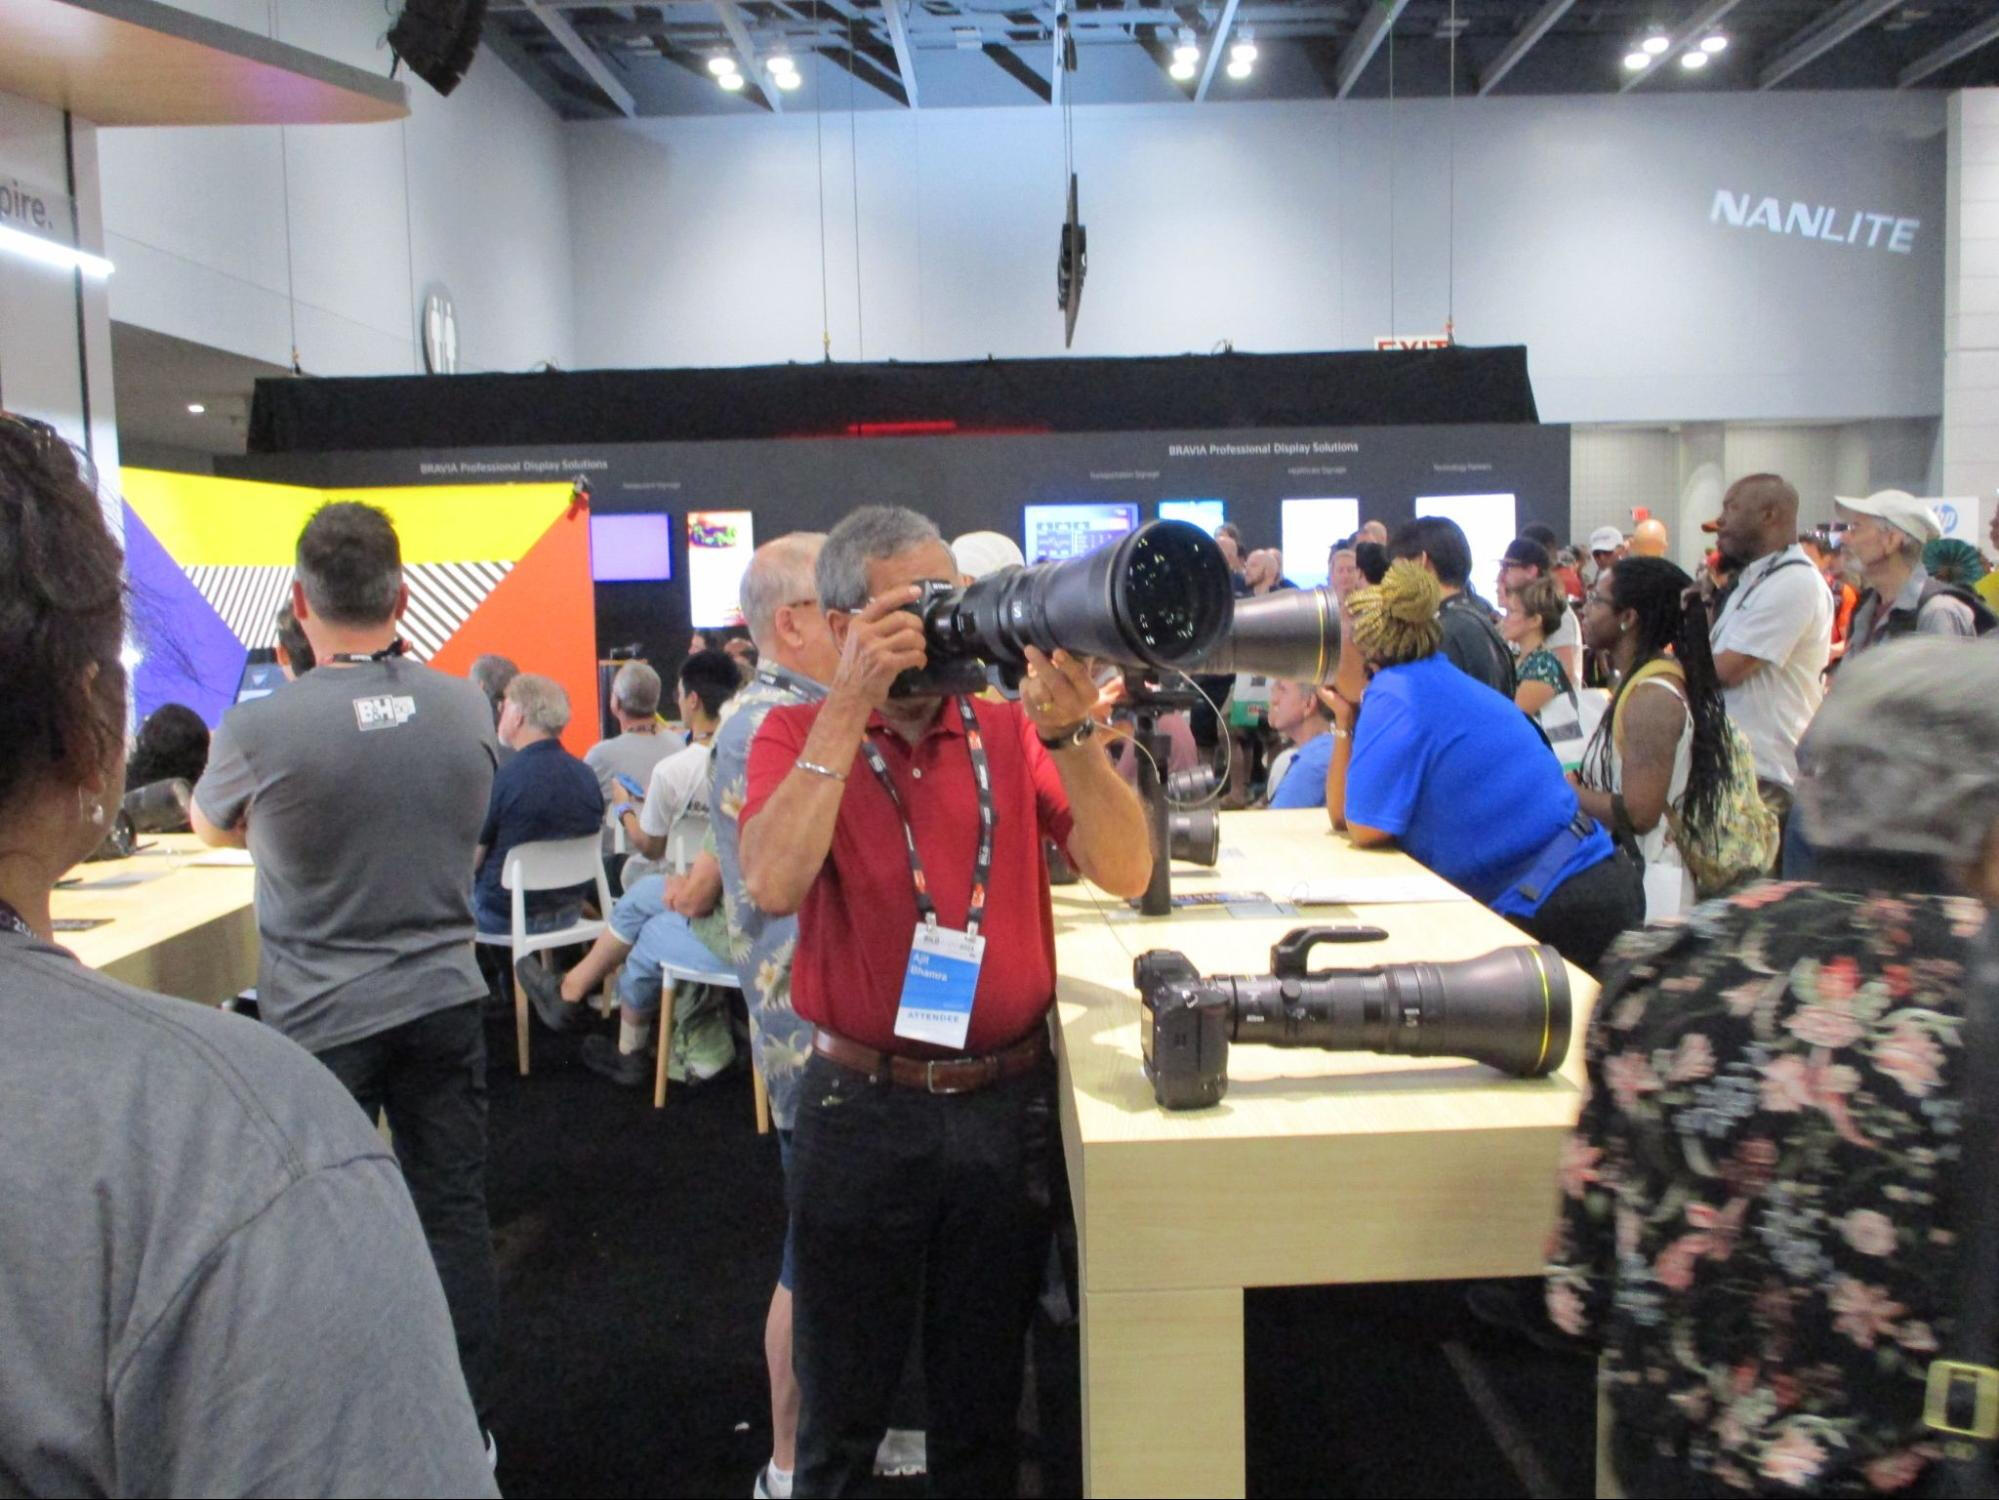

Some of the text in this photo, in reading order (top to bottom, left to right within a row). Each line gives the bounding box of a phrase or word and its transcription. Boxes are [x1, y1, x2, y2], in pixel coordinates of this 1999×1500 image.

[1709, 189, 1921, 254] NANLITE
[1169, 442, 1359, 456] BRAVIA Professional Display Solutions
[420, 459, 608, 475] BRAVIA Professional Display Solutions
[357, 697, 395, 723] B&H
[908, 1010, 960, 1023] ATTENDEE
